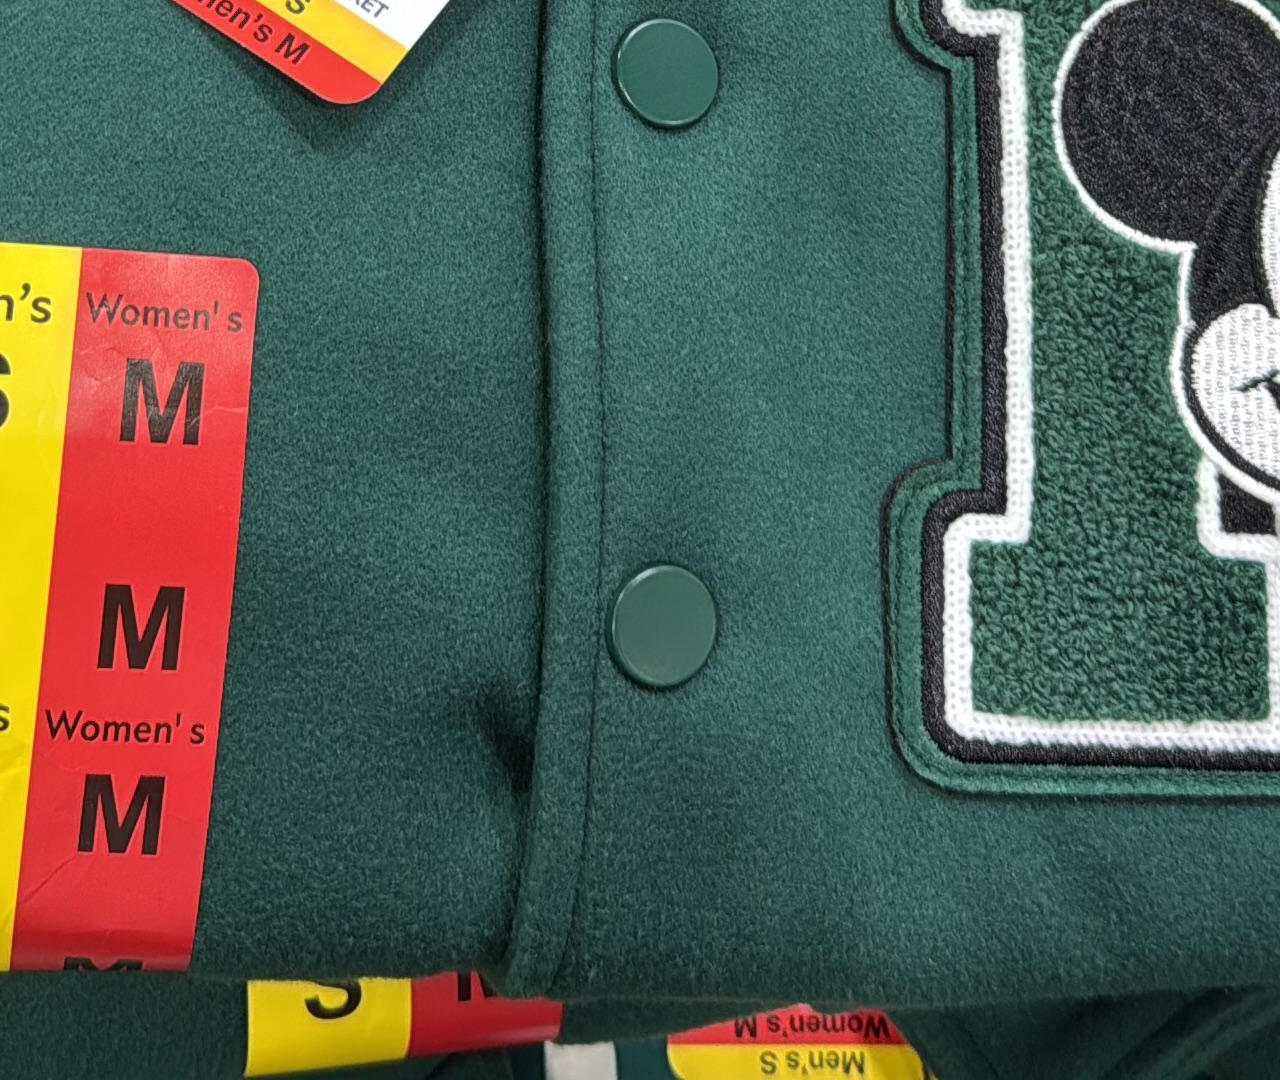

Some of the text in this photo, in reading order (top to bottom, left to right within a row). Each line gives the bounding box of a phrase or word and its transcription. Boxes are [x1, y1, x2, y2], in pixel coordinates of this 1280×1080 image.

[275, 31, 311, 67] M
[120, 357, 205, 446] M
[97, 583, 186, 671] M
[78, 773, 166, 855] M
[734, 1014, 891, 1039] Women's M
[759, 1050, 865, 1075] Men's S
